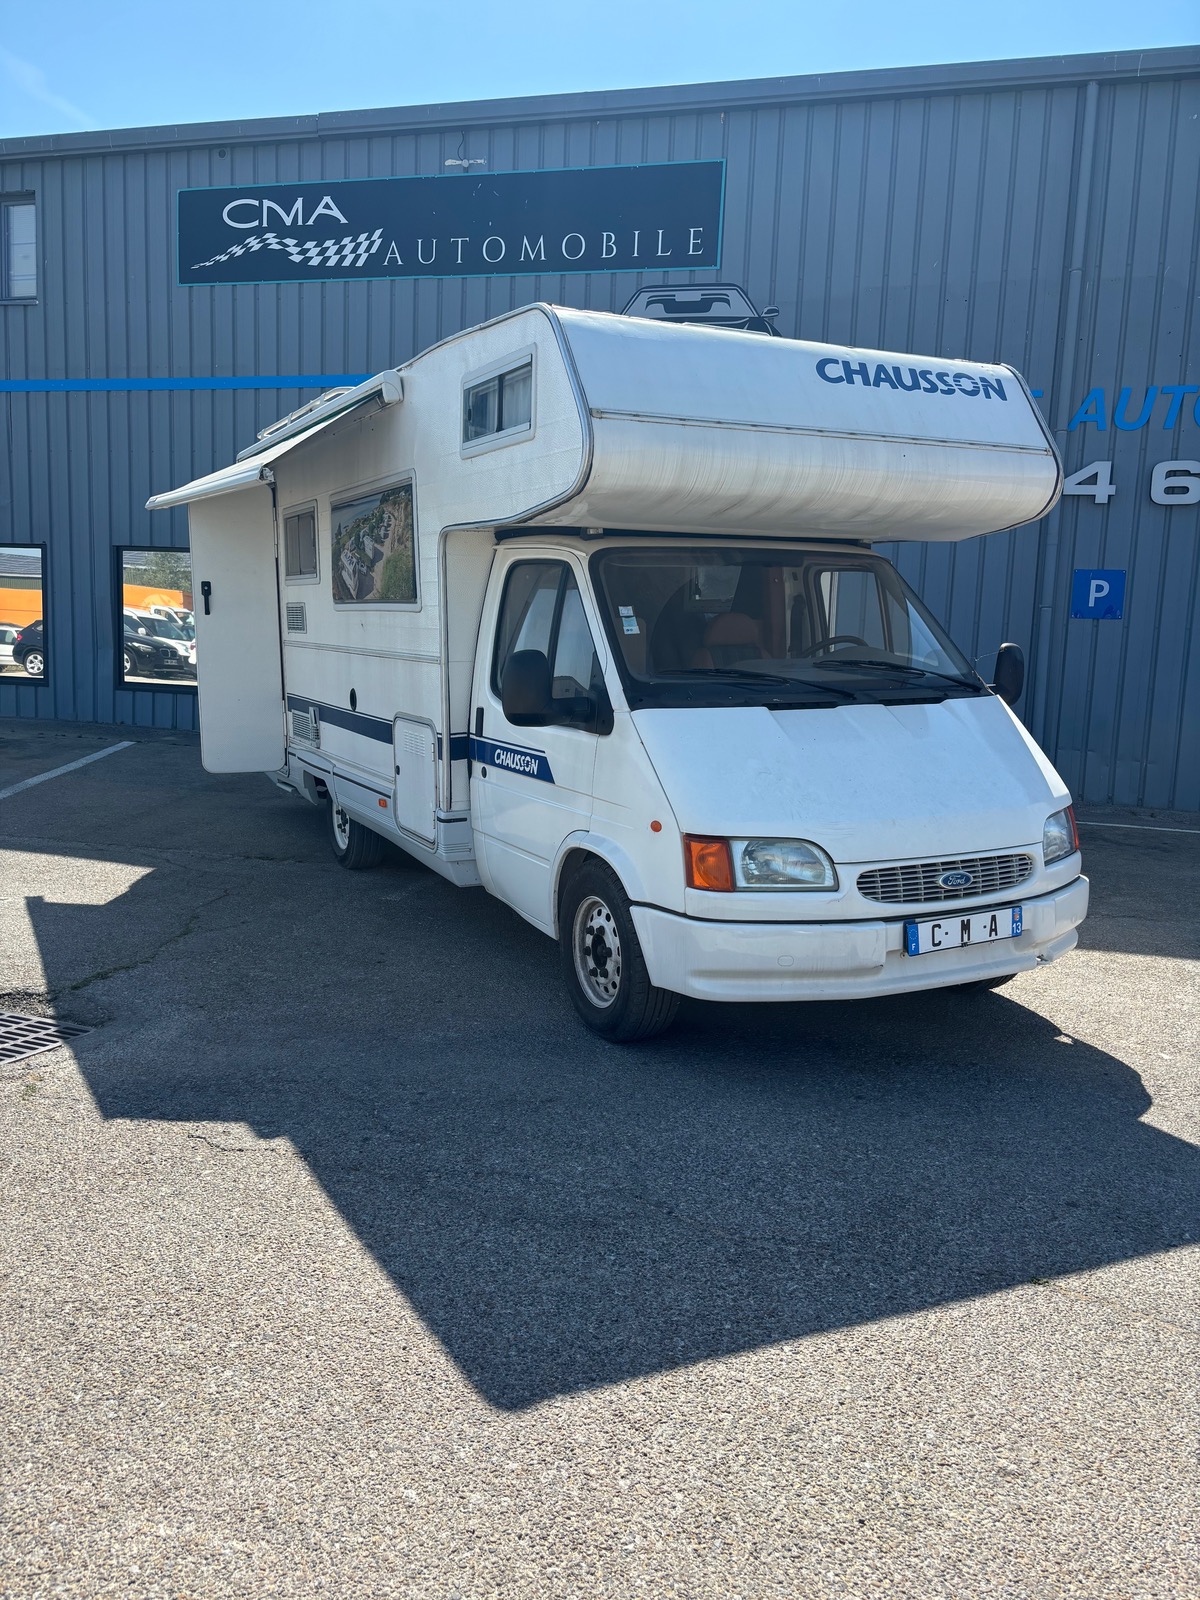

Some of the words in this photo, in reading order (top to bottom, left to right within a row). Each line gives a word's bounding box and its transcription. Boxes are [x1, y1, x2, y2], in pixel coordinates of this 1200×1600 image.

[222, 196, 348, 229] CMA
[383, 227, 704, 266] AUTOMOBILE
[815, 358, 1007, 401] CHAUSSON
[1067, 385, 1200, 431] AUT
[1088, 580, 1110, 607] P
[494, 749, 539, 775] CHAUSSON
[947, 874, 966, 886] Ford
[1012, 922, 1022, 934] 13
